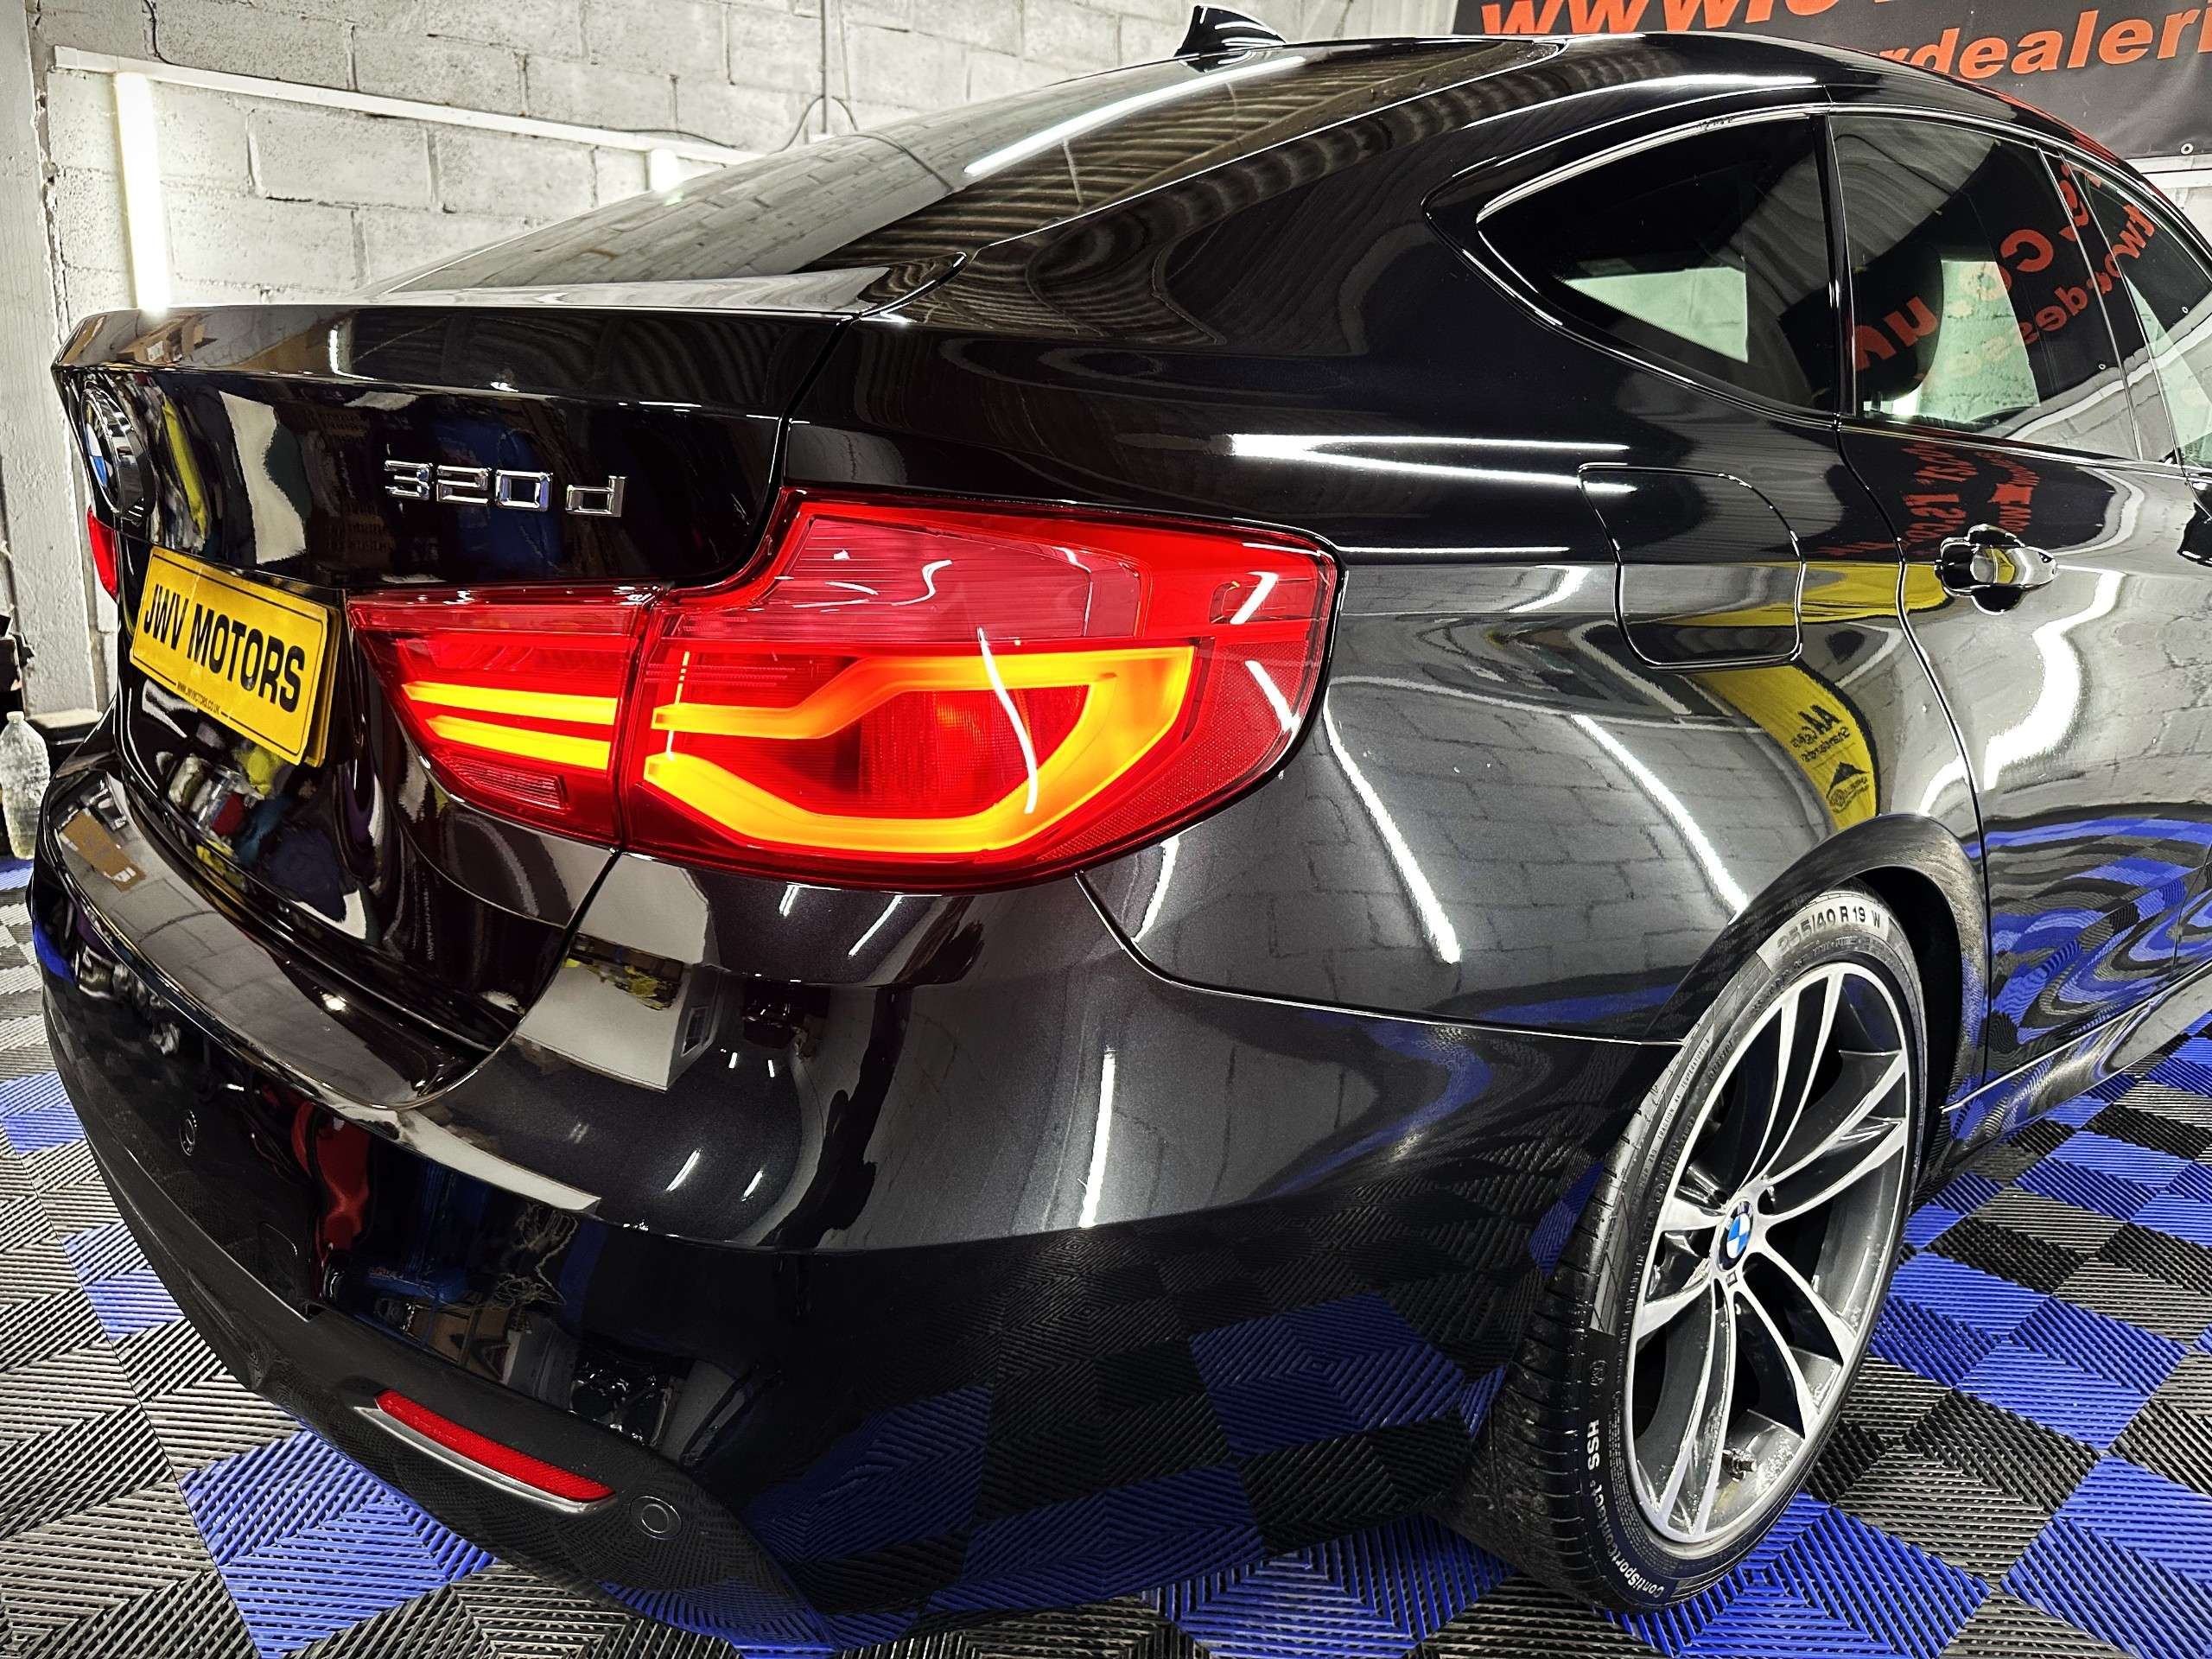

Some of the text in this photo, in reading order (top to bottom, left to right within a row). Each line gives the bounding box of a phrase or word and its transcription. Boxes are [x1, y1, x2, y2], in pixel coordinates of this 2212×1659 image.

[143, 583, 306, 713] JWV MOTORS
[1586, 1419, 1600, 1471] SSR
